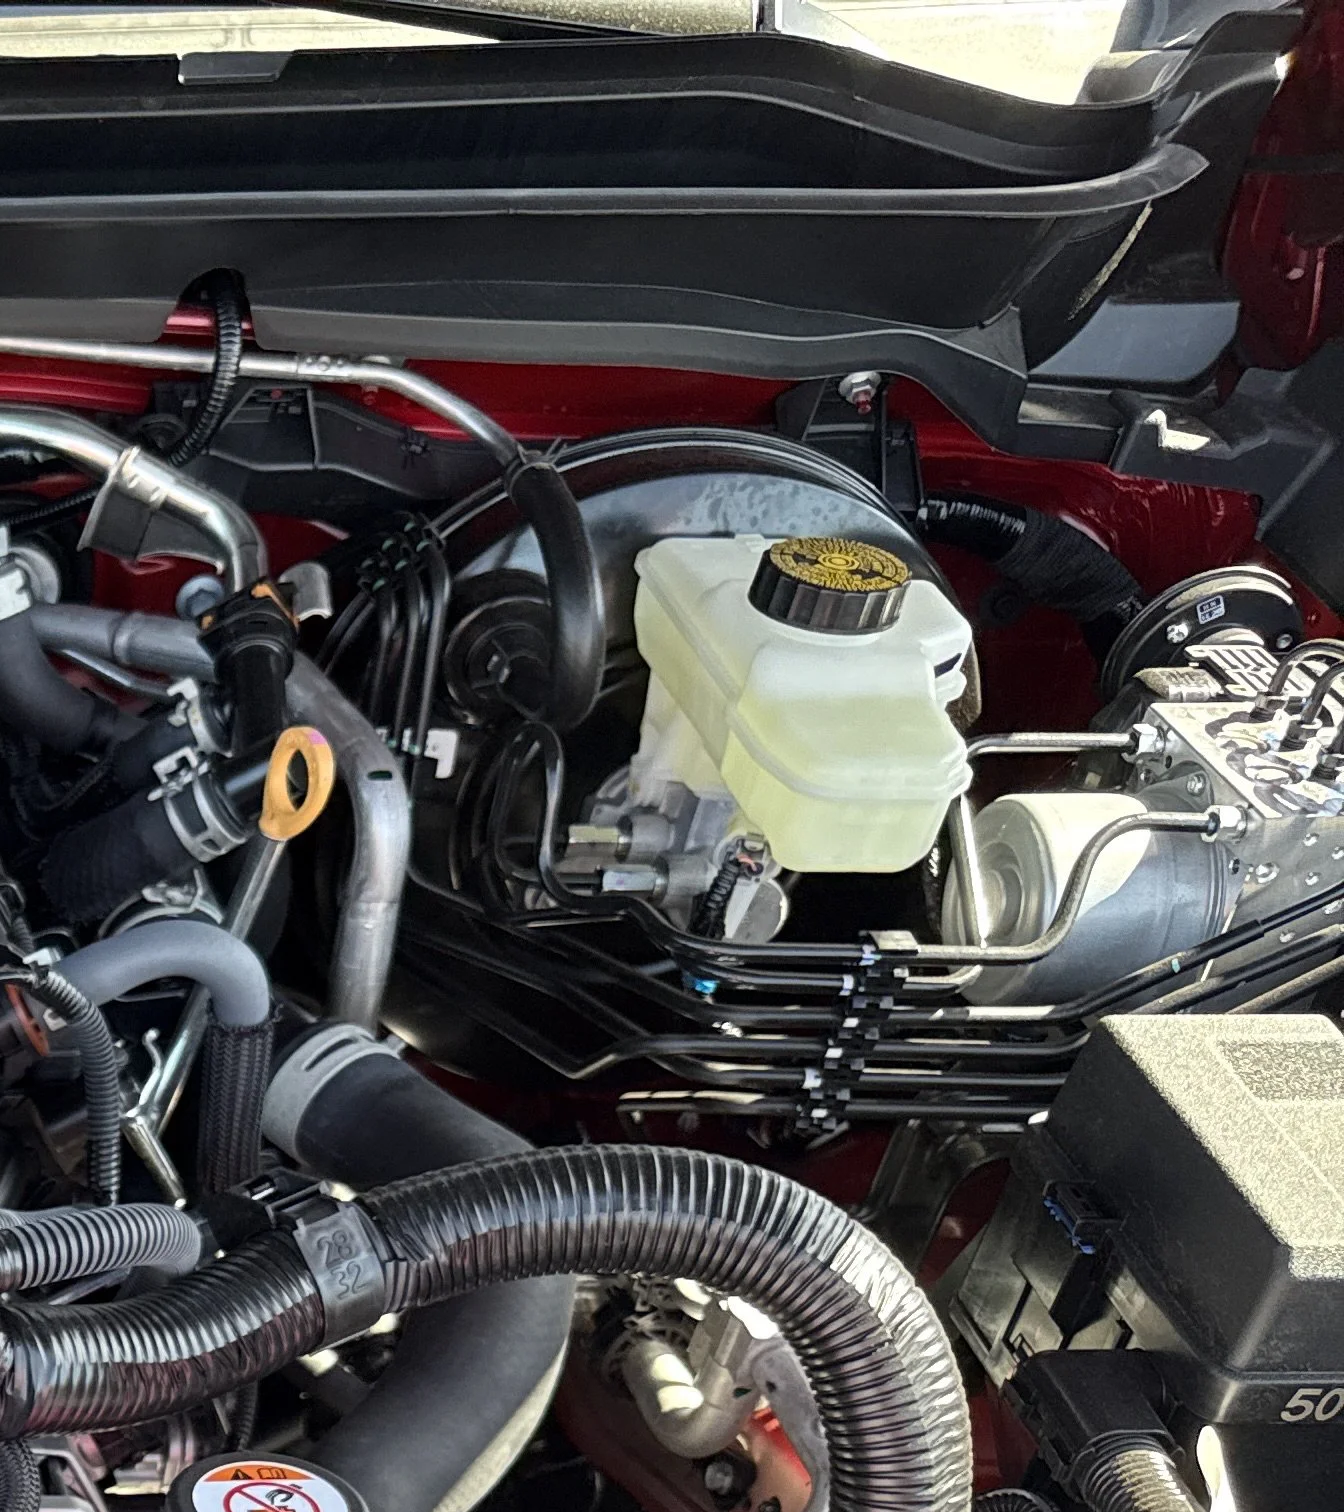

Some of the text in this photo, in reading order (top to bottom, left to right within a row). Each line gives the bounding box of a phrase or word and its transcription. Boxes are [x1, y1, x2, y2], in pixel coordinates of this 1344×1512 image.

[317, 1229, 352, 1270] 28
[330, 1260, 370, 1300] 32
[1280, 1387, 1344, 1422] 50
